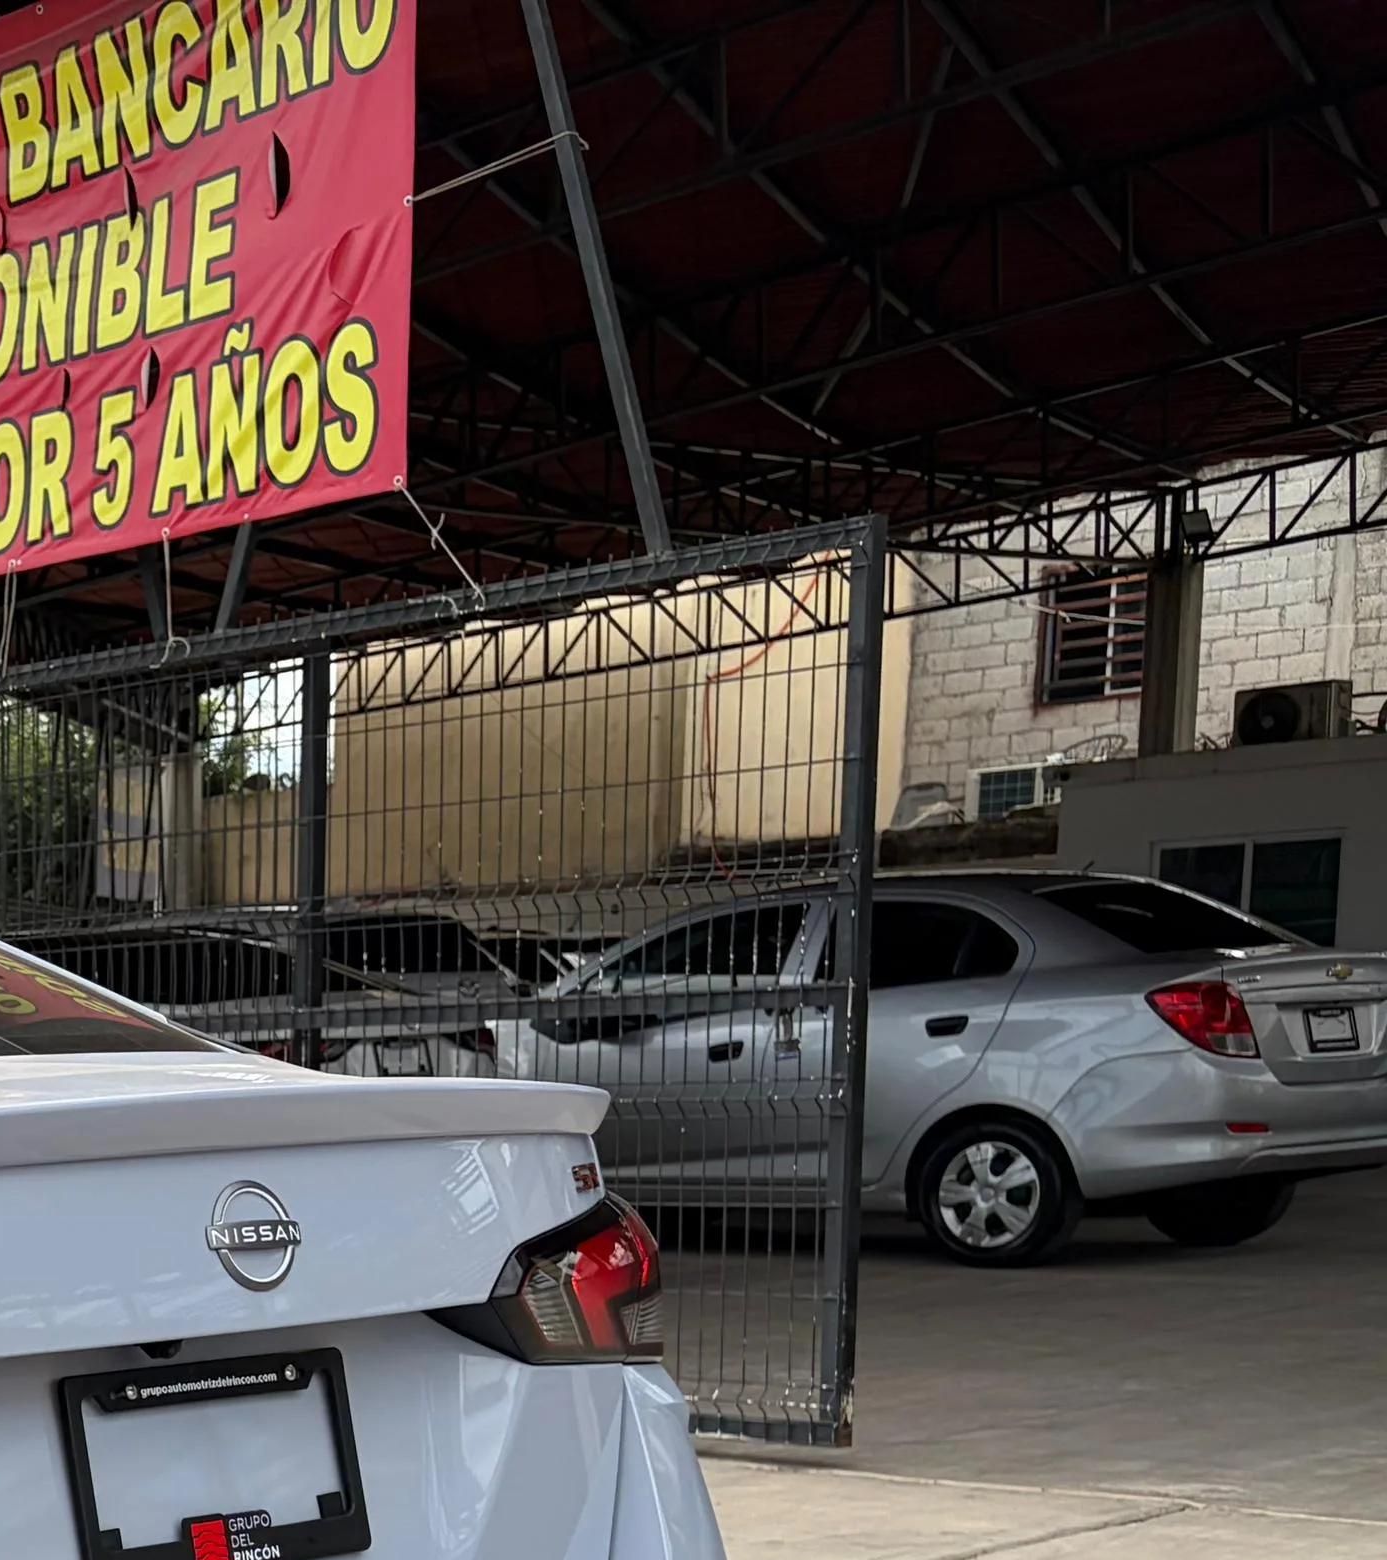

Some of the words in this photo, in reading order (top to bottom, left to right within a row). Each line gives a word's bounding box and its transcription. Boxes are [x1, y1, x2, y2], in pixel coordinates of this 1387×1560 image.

[91, 385, 135, 532] 5
[149, 316, 380, 520] AÑOS
[210, 1224, 300, 1246] NISSAN
[140, 1372, 278, 1399] grupoautomotrizdelrincon.com
[228, 1513, 270, 1532] GRUPO
[231, 1533, 254, 1548] DEL
